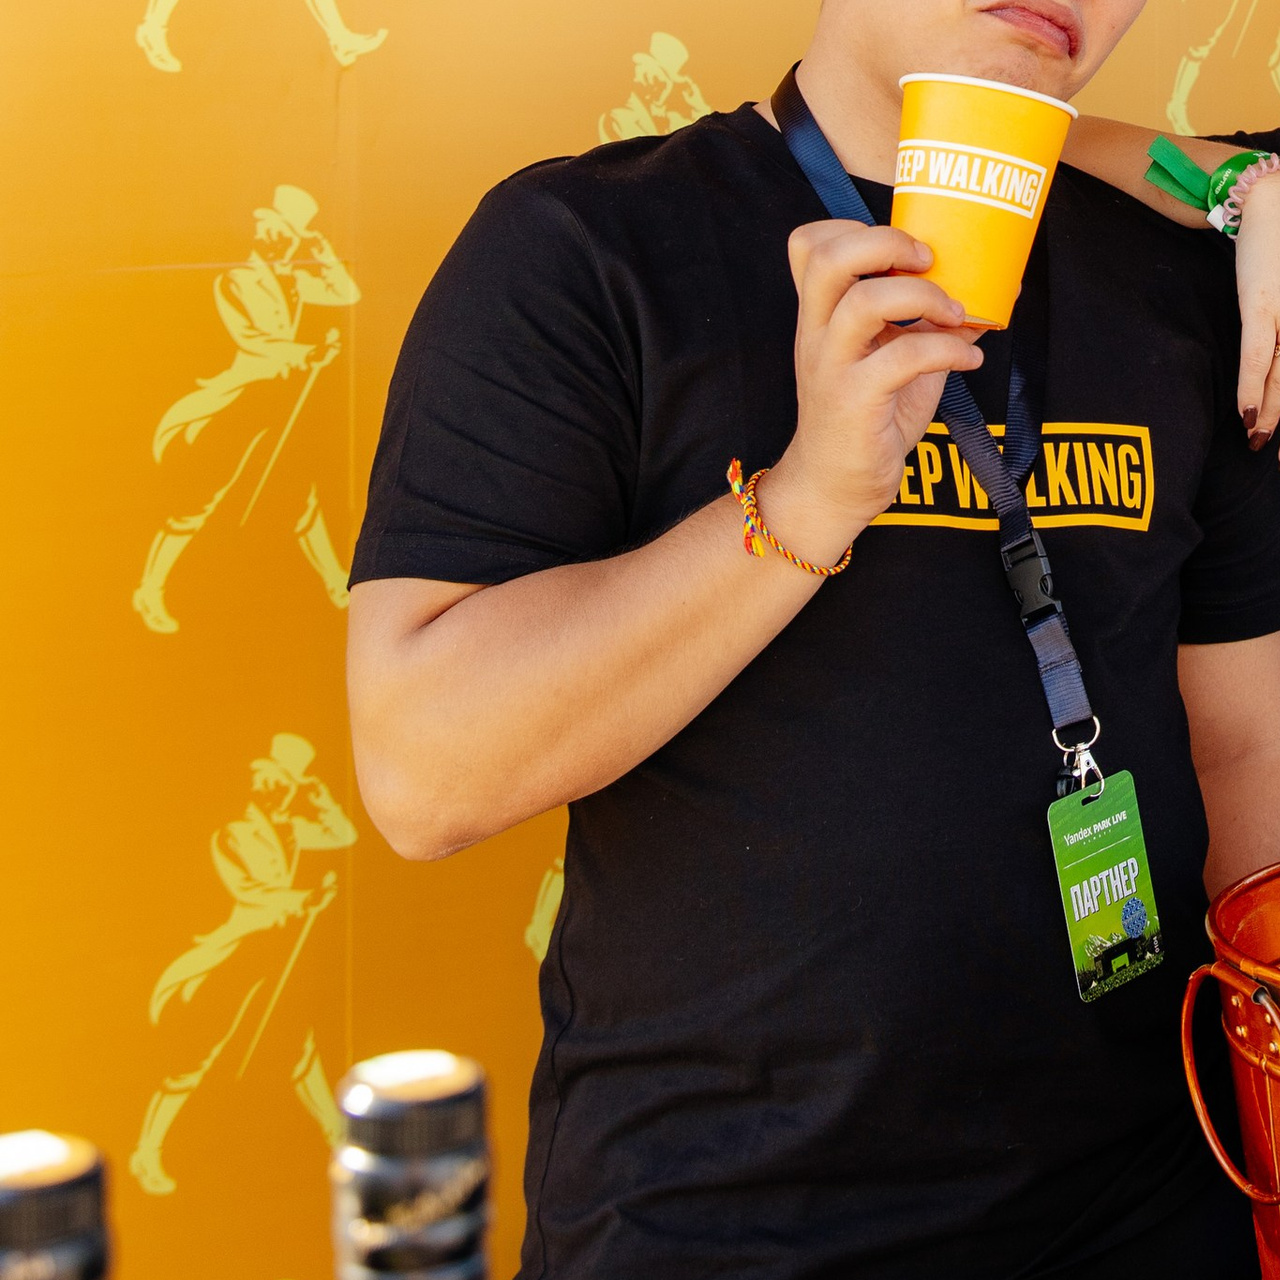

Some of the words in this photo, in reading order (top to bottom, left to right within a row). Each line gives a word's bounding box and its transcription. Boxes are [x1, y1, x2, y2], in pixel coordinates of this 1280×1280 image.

[895, 149, 926, 183] EEP
[928, 150, 1040, 208] WALKING
[947, 441, 1142, 510] WLKING
[1063, 826, 1093, 847] Yandex
[1093, 816, 1112, 834] PARK
[1111, 809, 1128, 825] LIVE
[1069, 856, 1140, 923] ПАРТНЕР
